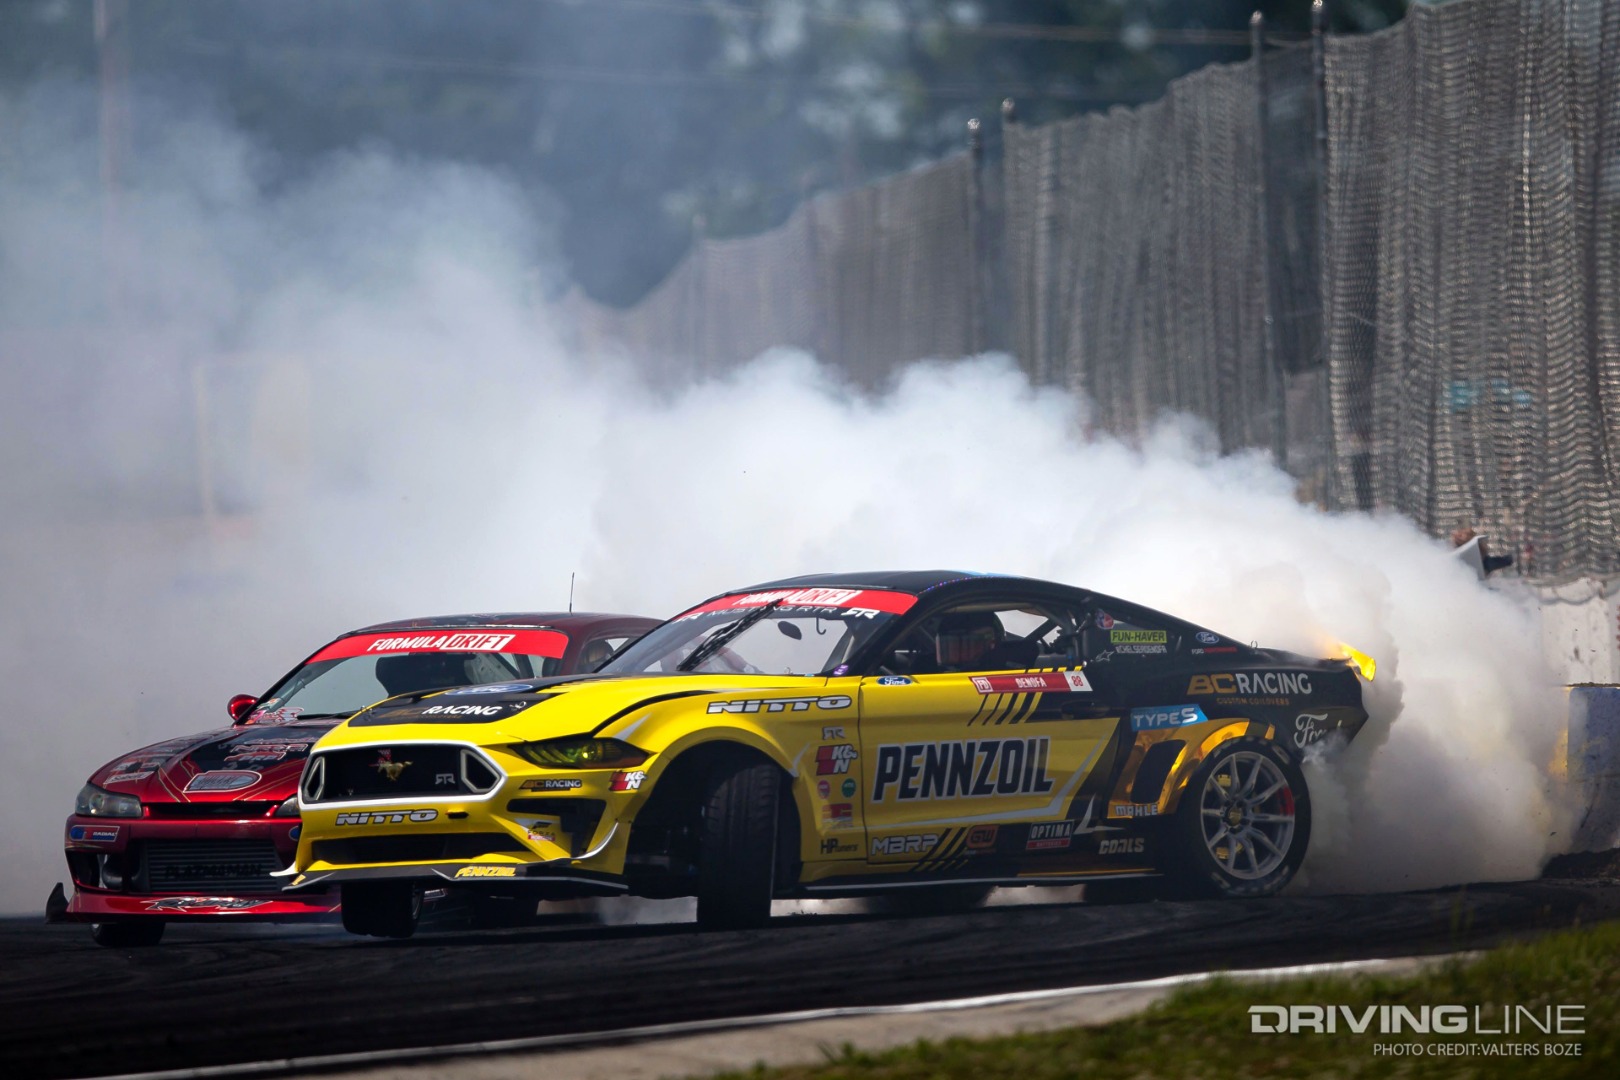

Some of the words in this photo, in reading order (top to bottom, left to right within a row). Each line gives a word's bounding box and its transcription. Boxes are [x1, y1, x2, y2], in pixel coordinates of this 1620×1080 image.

[1112, 631, 1165, 642] FUN-HAVER
[1015, 677, 1047, 688] DENOFA
[706, 695, 852, 714] NITTO
[871, 735, 1055, 804] PENNZOIL
[336, 809, 438, 826] NITTO
[1115, 804, 1158, 816] MAHLE
[1031, 823, 1071, 839] OPTIMA
[871, 834, 939, 856] MBRP
[454, 866, 516, 878] PENNZOIL
